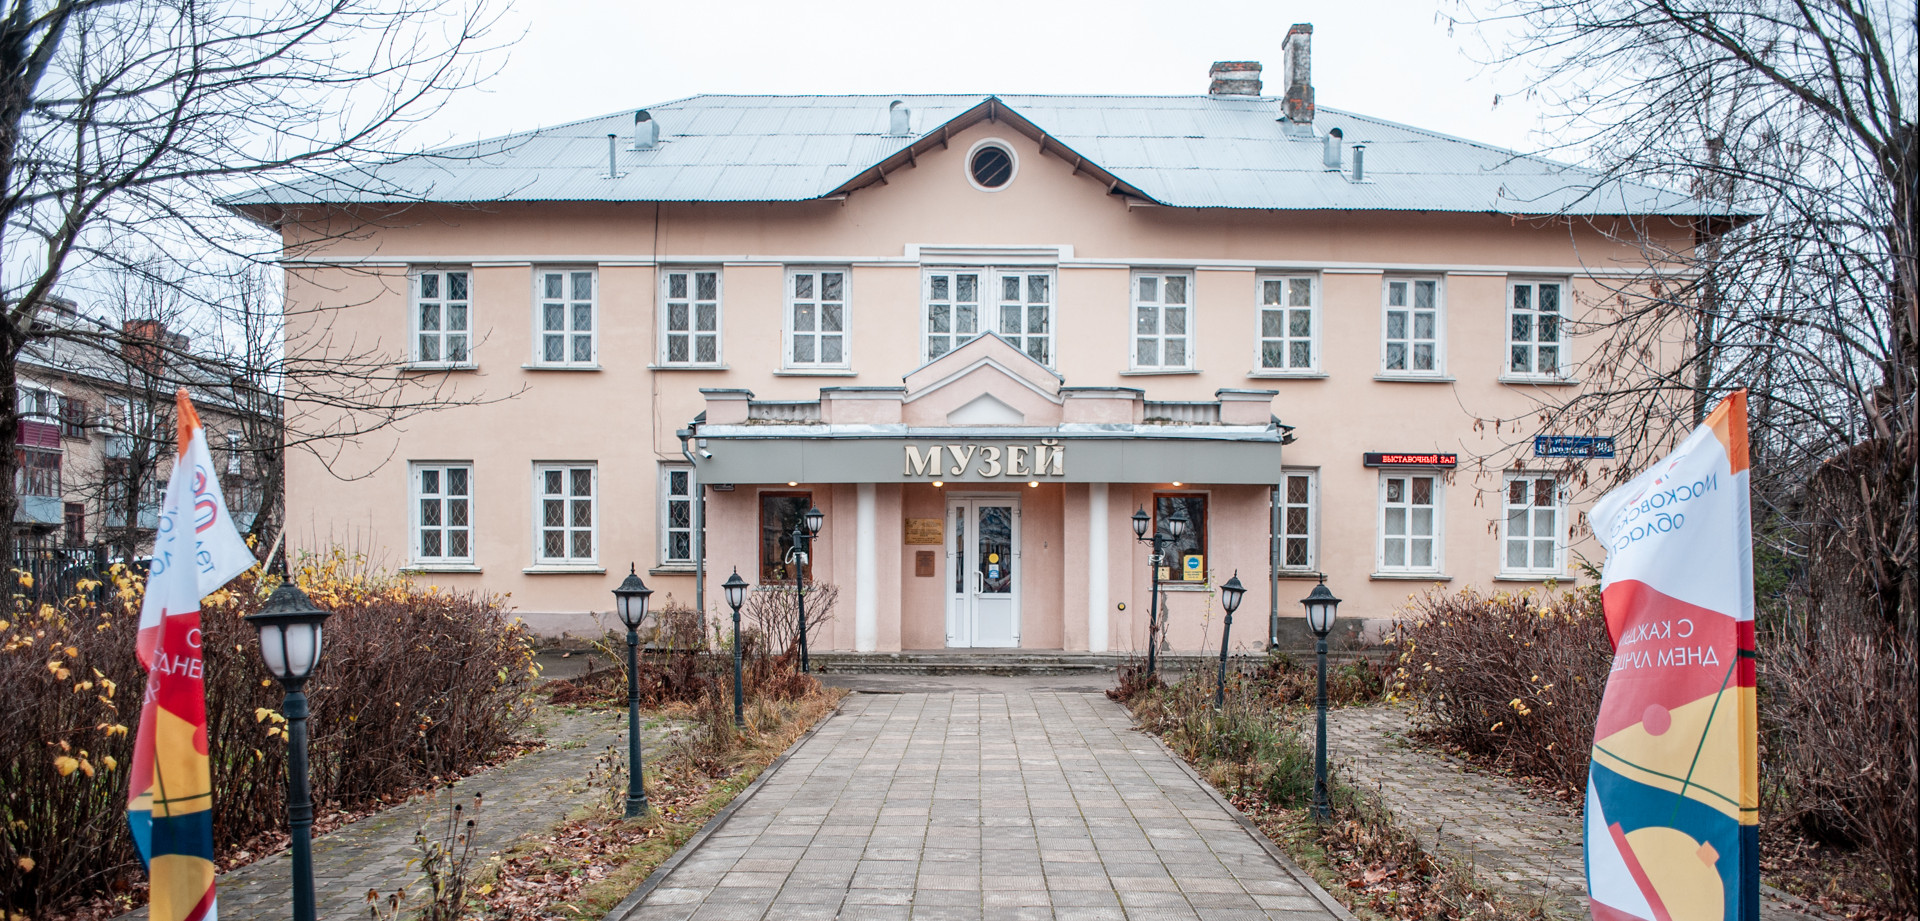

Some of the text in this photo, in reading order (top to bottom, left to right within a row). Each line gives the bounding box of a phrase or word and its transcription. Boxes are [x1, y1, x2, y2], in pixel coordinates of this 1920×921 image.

[903, 438, 1066, 478] МУЗЕЙ
[1382, 454, 1456, 464] ВЫСТАВОЧНЫЙ ЗАЛ
[186, 628, 201, 648] С
[158, 652, 204, 680] ДНЕ
